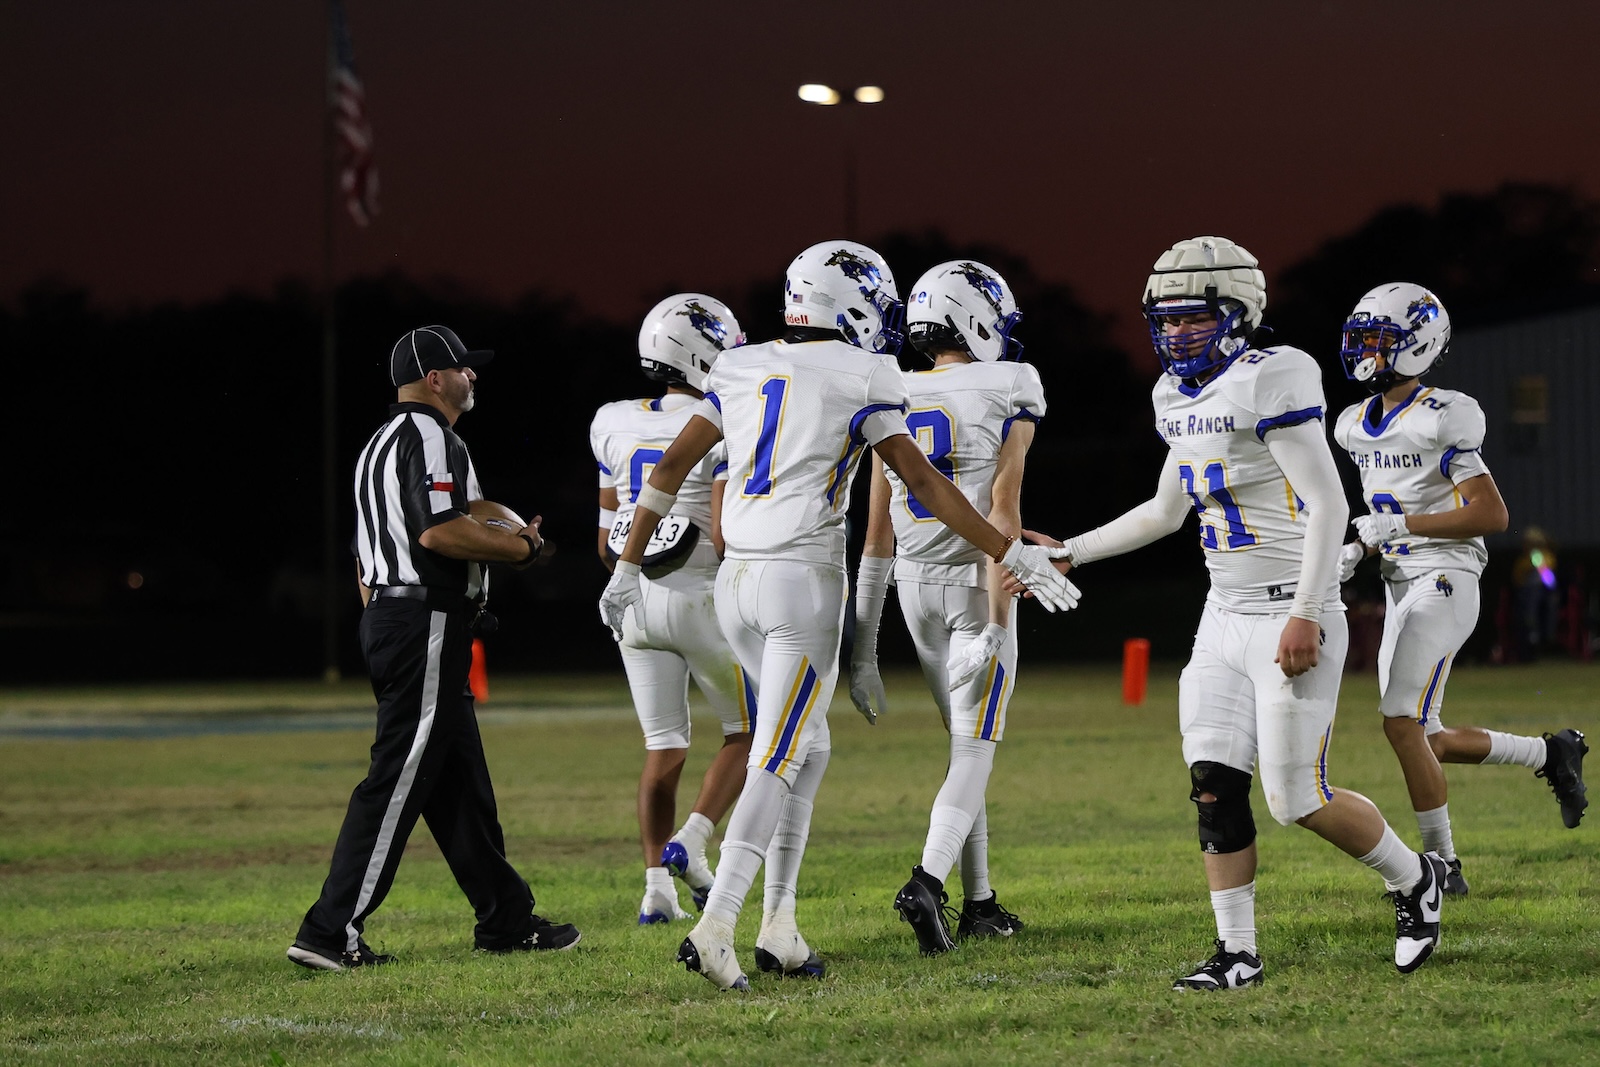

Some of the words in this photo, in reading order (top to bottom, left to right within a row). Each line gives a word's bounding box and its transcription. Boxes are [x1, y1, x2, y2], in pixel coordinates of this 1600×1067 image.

[1421, 397, 1446, 411] 2
[1188, 414, 1236, 436] RANCH
[741, 374, 791, 499] 1
[1374, 451, 1423, 469] RANCH
[1178, 458, 1261, 552] 21
